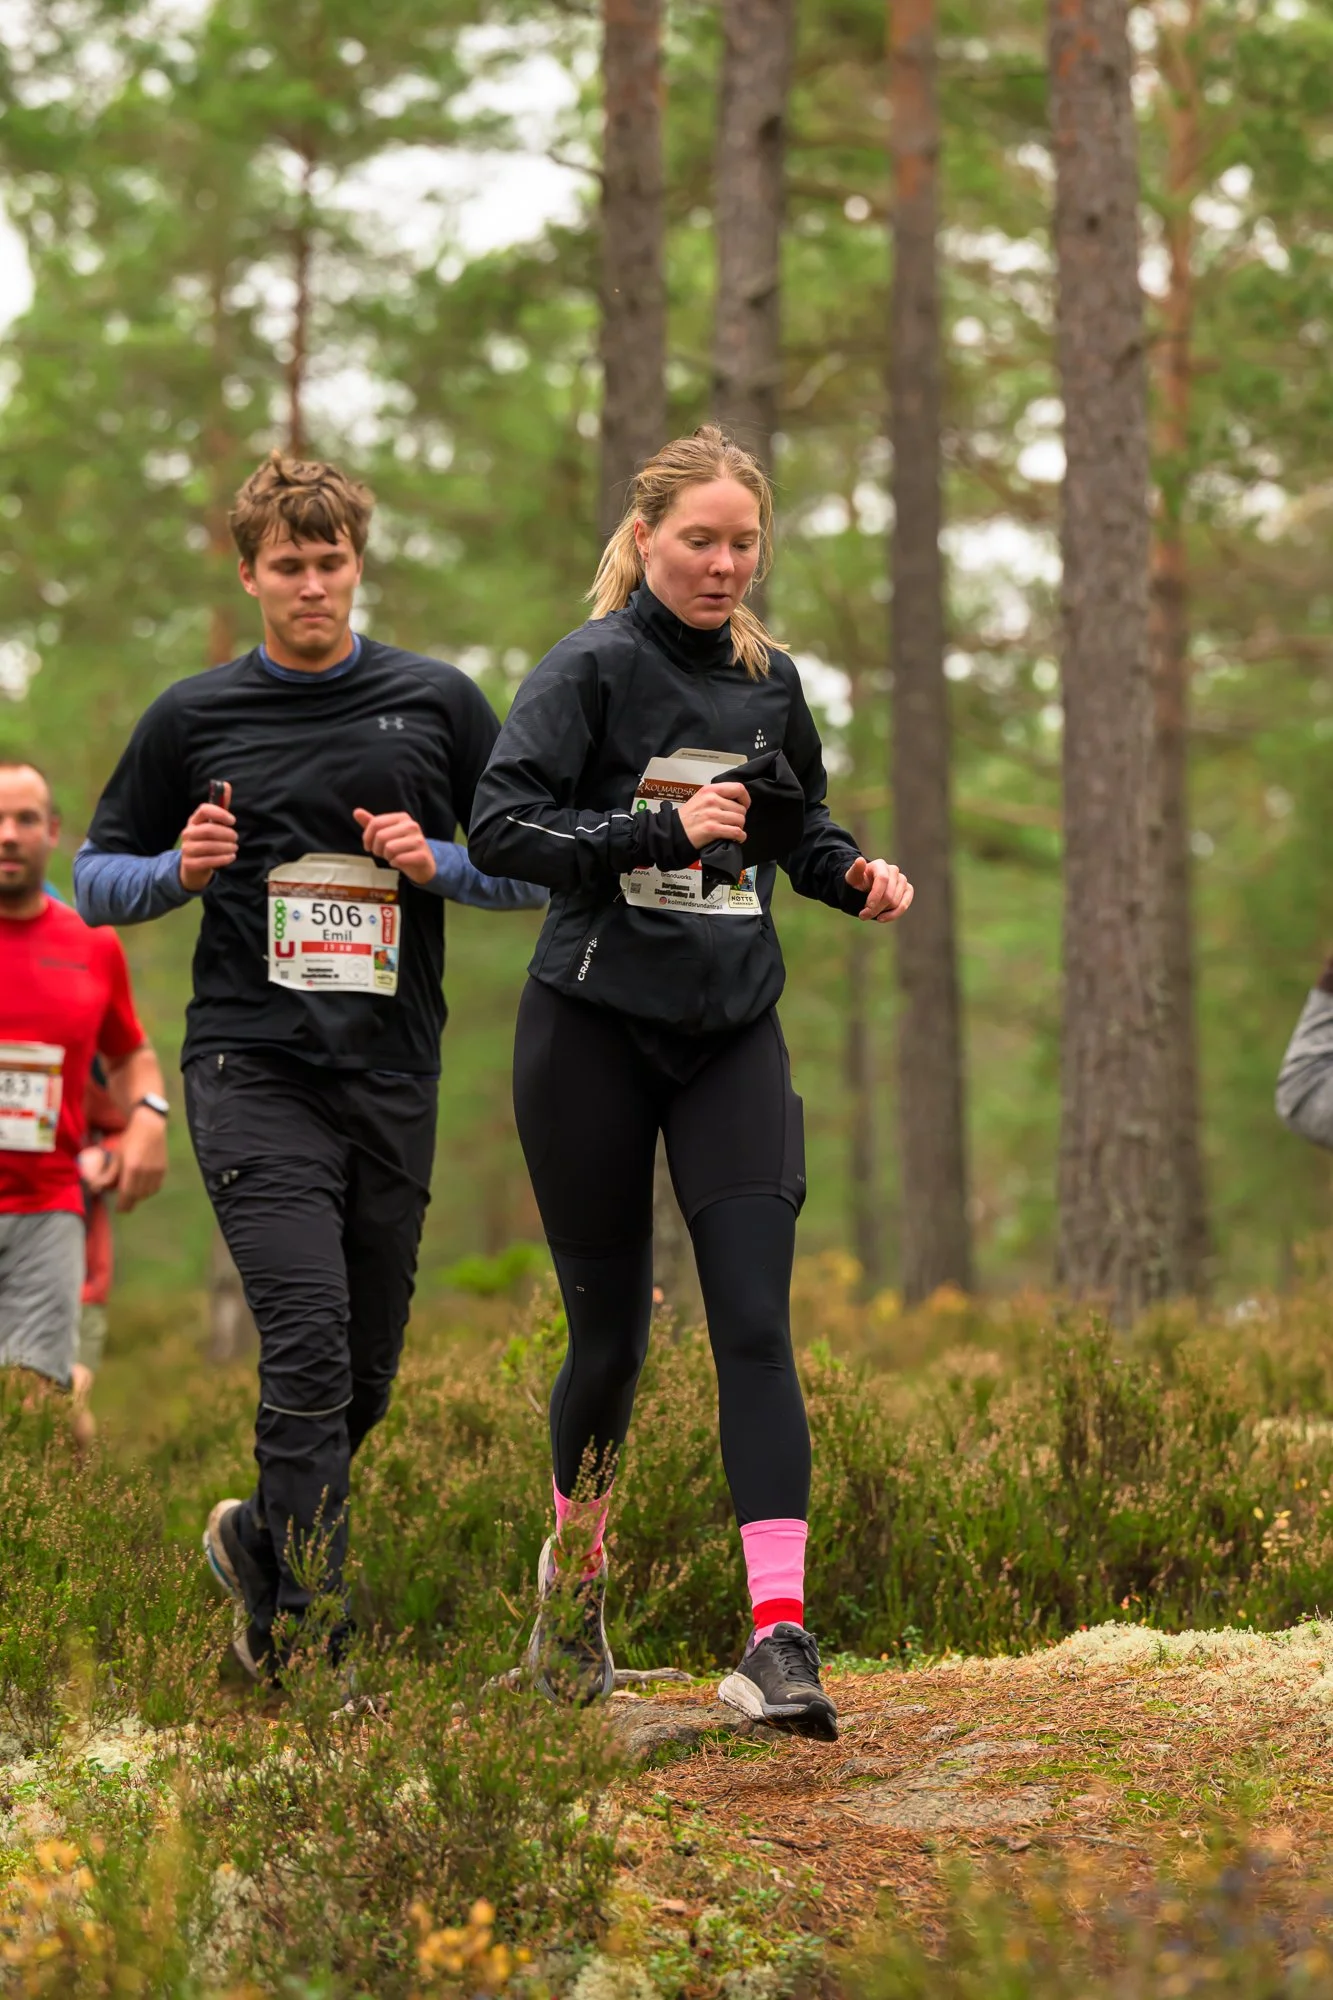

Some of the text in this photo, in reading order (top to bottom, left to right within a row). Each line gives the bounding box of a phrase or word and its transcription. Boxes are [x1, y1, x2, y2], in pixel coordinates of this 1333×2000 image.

[311, 903, 362, 927] 506
[323, 929, 353, 942] Emil
[577, 946, 594, 982] CRAFT
